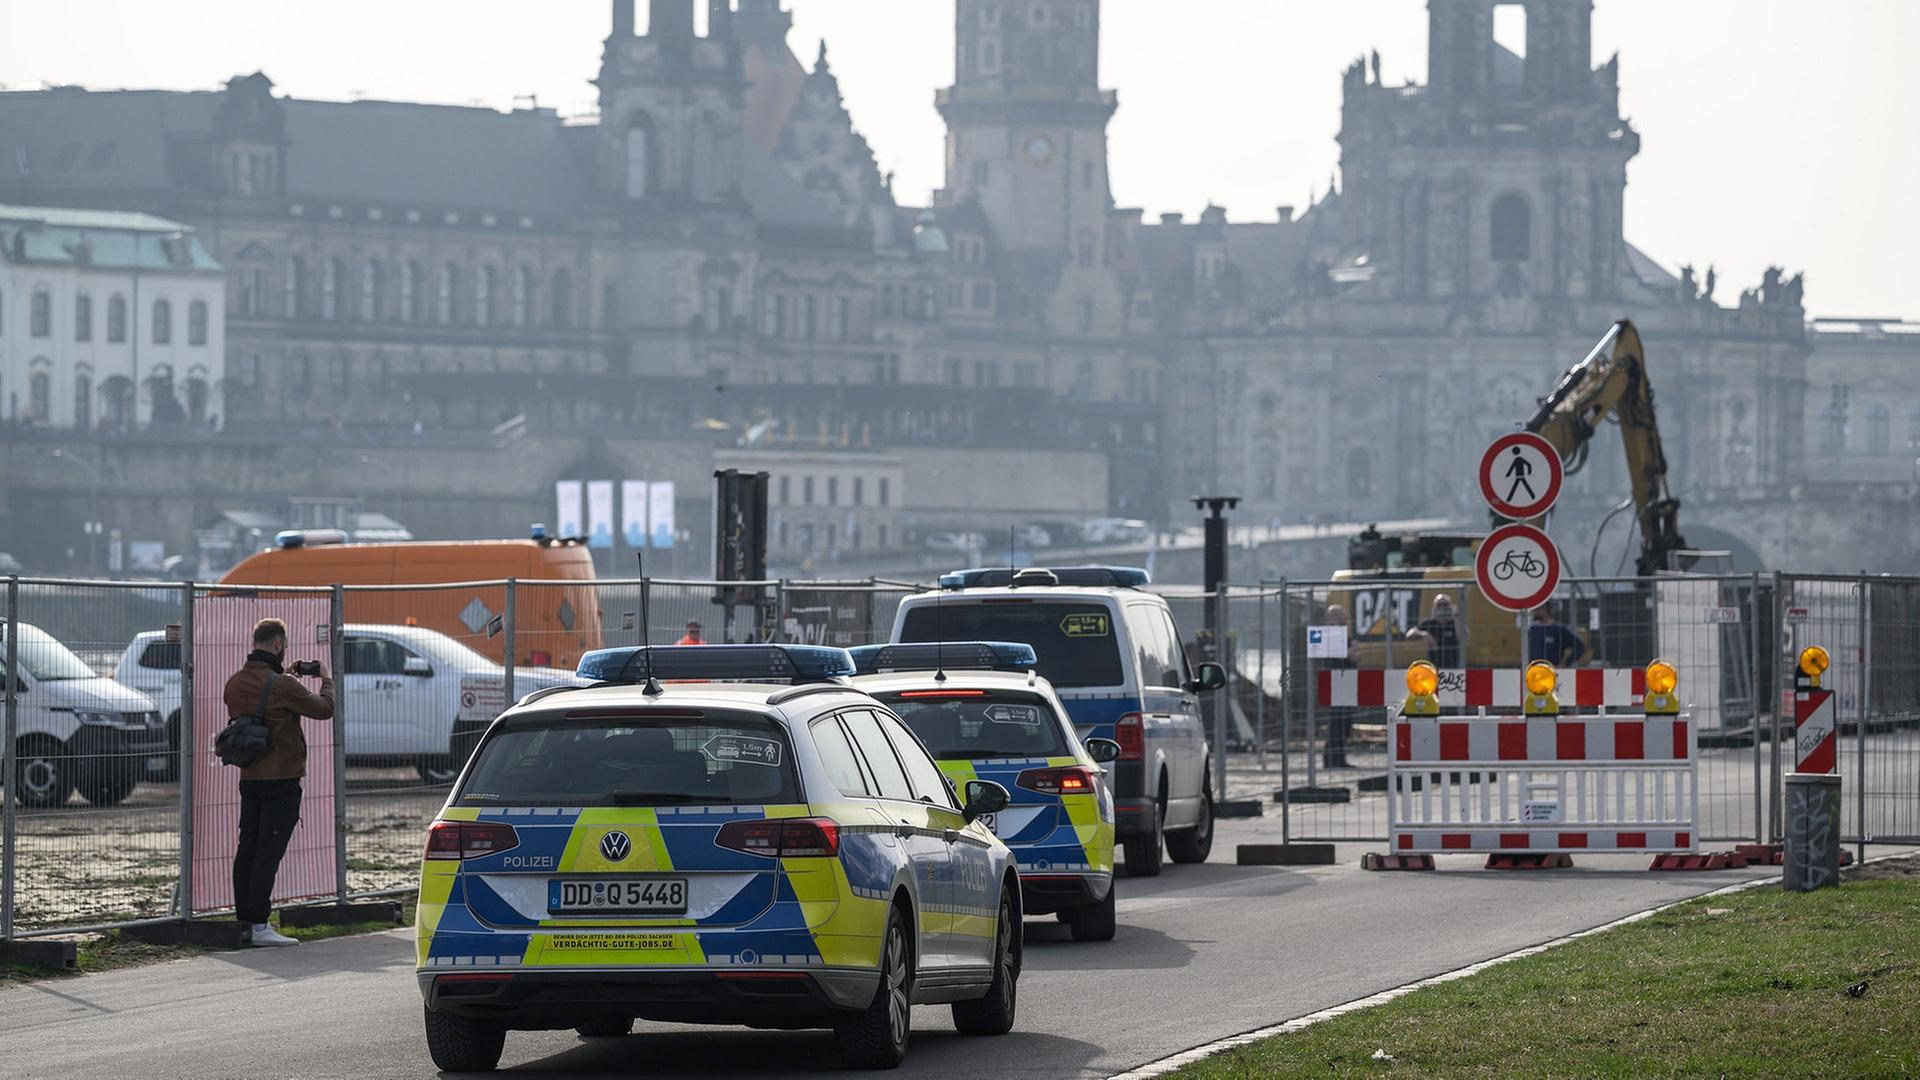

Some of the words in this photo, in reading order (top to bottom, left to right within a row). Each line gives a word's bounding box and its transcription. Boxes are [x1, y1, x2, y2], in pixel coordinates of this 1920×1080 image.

[1355, 590, 1413, 636] CAT
[503, 855, 554, 868] POLIZEI
[563, 883, 592, 906] DD
[607, 883, 621, 906] Q
[627, 883, 683, 905] 5448
